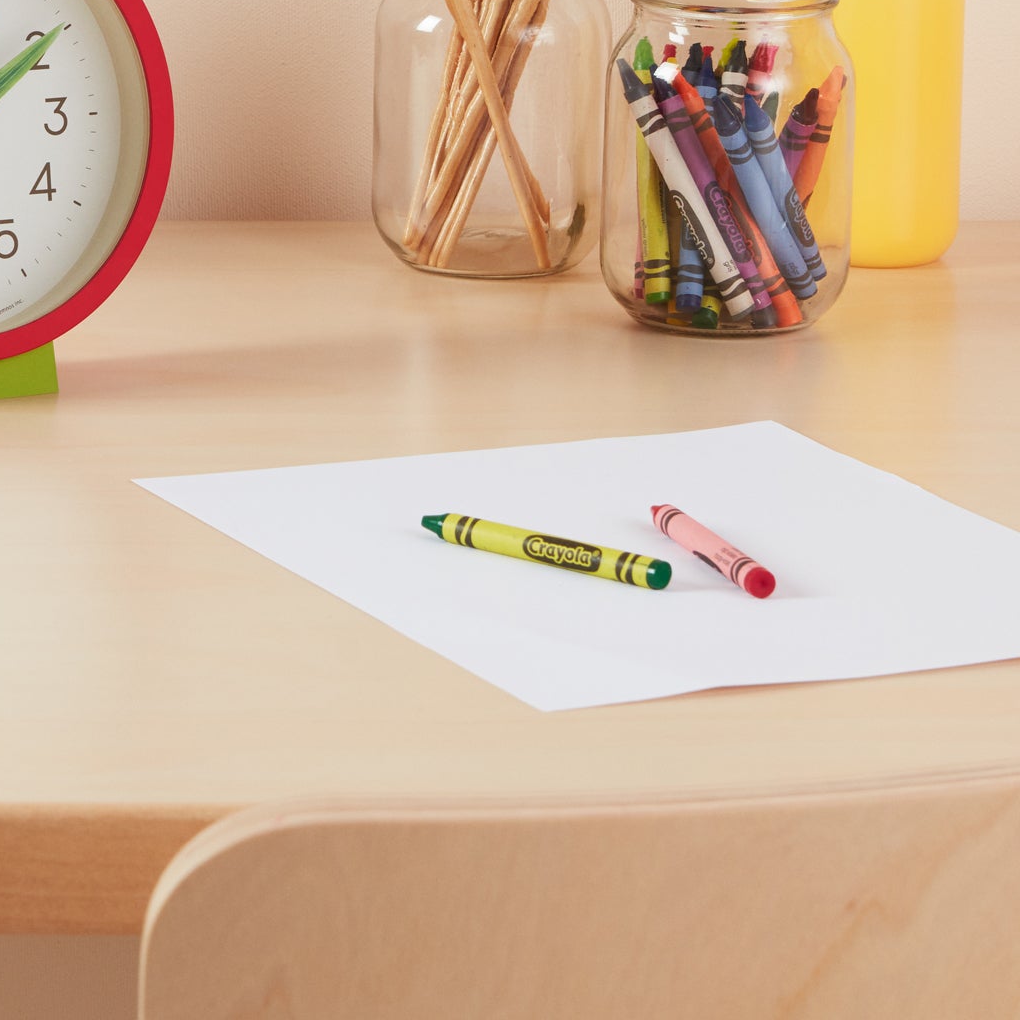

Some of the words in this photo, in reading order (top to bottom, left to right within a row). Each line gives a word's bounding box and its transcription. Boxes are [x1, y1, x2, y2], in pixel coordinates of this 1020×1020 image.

[43, 96, 68, 136] 3
[28, 161, 57, 202] 4
[709, 186, 745, 254] Crayola
[528, 538, 591, 567] Crayola
